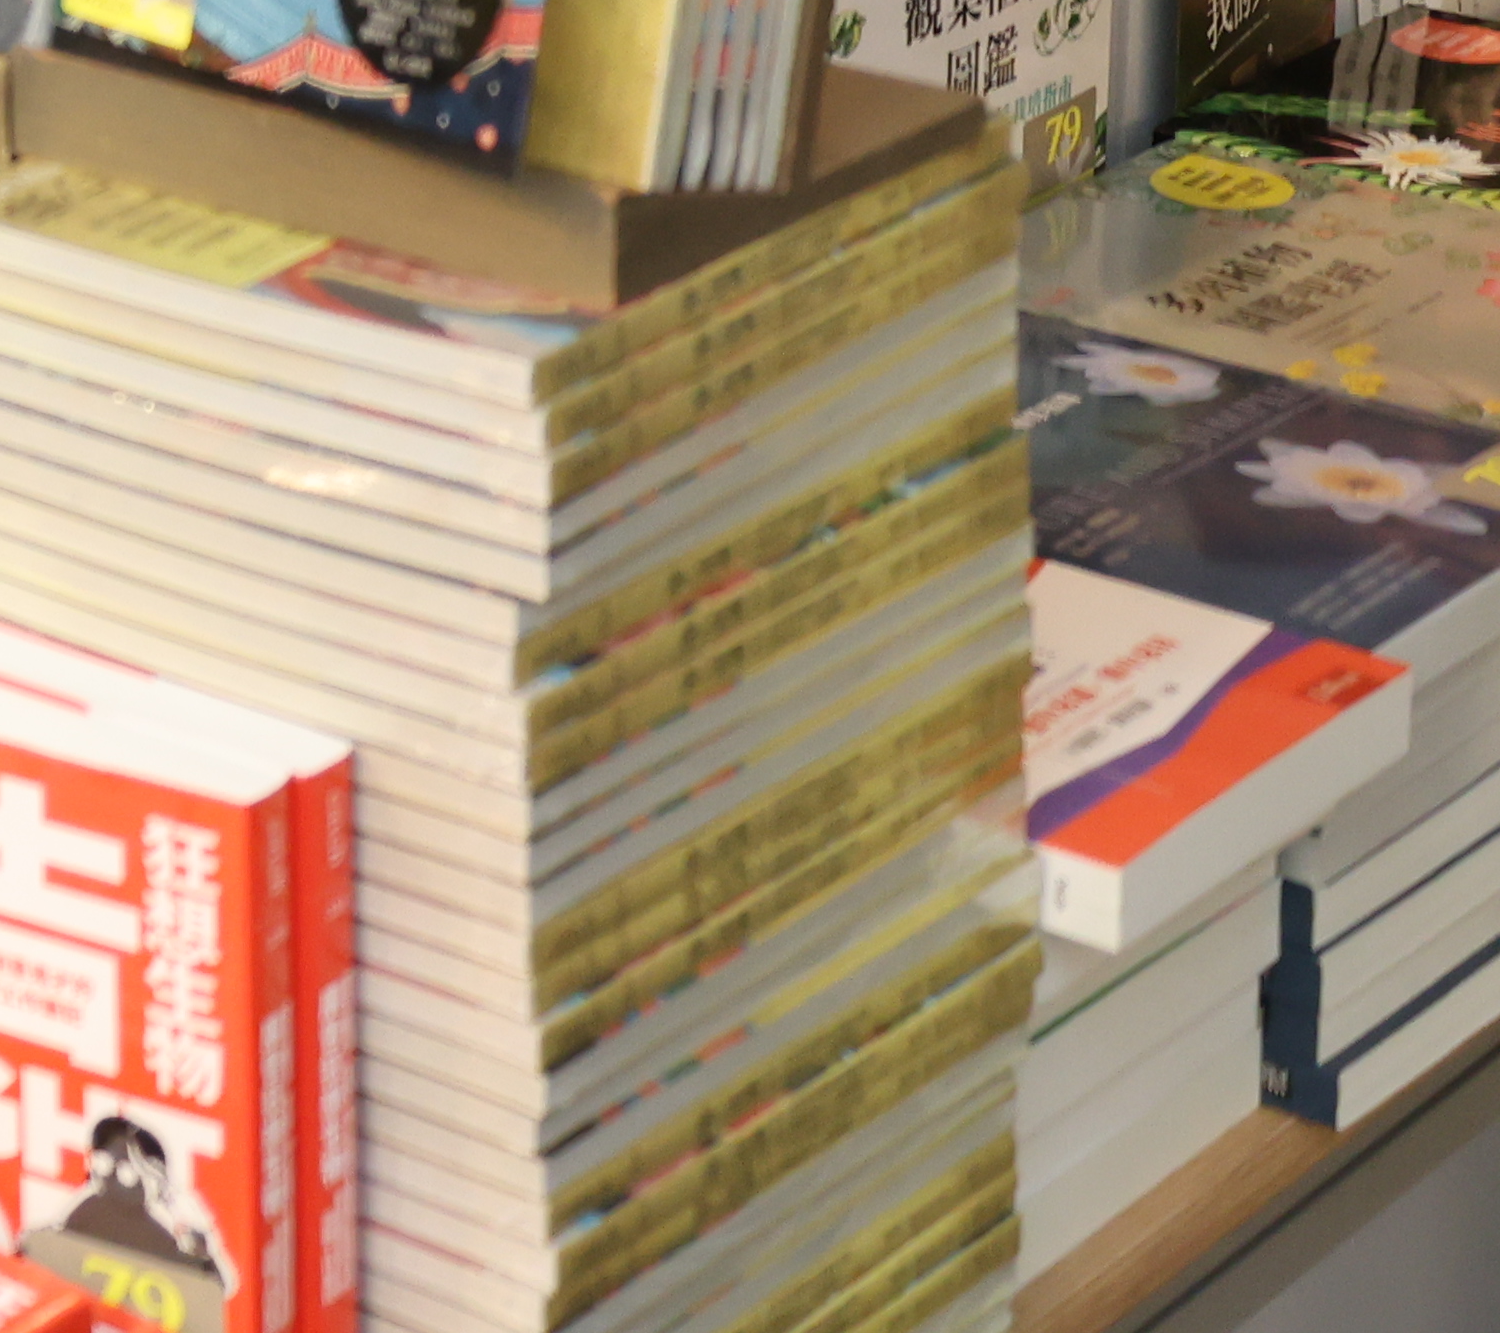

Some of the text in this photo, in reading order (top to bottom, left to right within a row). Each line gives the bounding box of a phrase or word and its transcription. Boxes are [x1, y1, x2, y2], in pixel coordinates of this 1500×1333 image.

[945, 25, 1021, 96] 圖鑑
[1043, 105, 1082, 164] 79
[140, 813, 226, 1110] 狂想生物
[80, 1257, 187, 1332] 79
